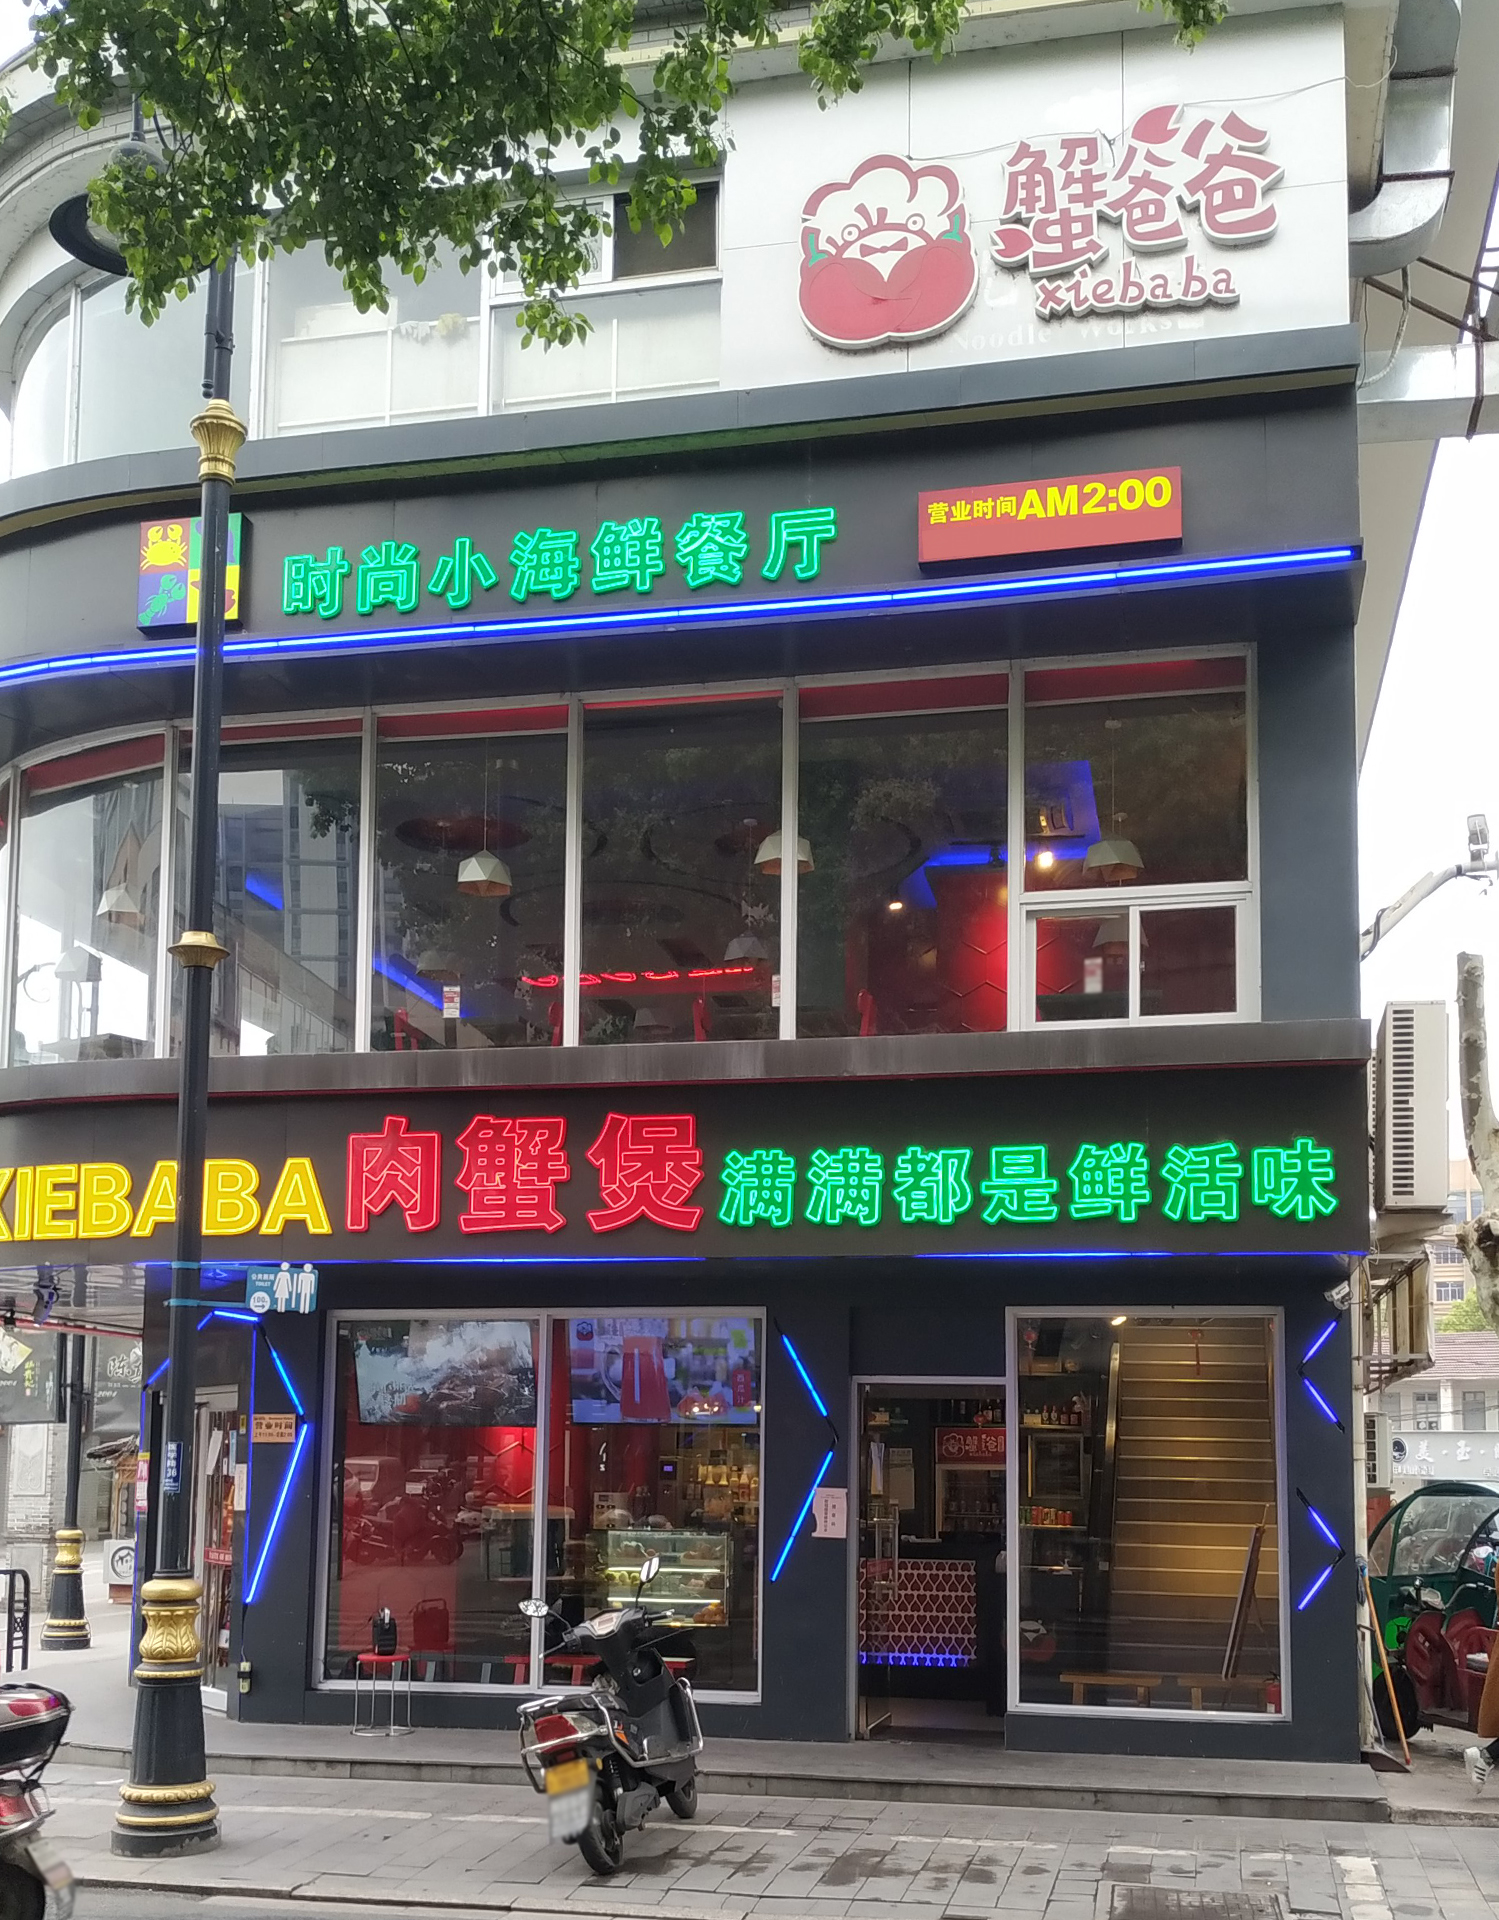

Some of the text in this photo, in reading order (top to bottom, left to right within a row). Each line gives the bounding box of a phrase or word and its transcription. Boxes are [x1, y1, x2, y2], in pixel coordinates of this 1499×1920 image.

[991, 104, 1284, 270] 蟹爸爸
[1036, 254, 1237, 311] xiebaba
[927, 476, 1172, 525] 营业时间 AM2:00
[280, 506, 838, 620] 时尚小海鲜餐厅
[345, 1112, 1338, 1234] 肉蟹煲 满满都是鲜活味
